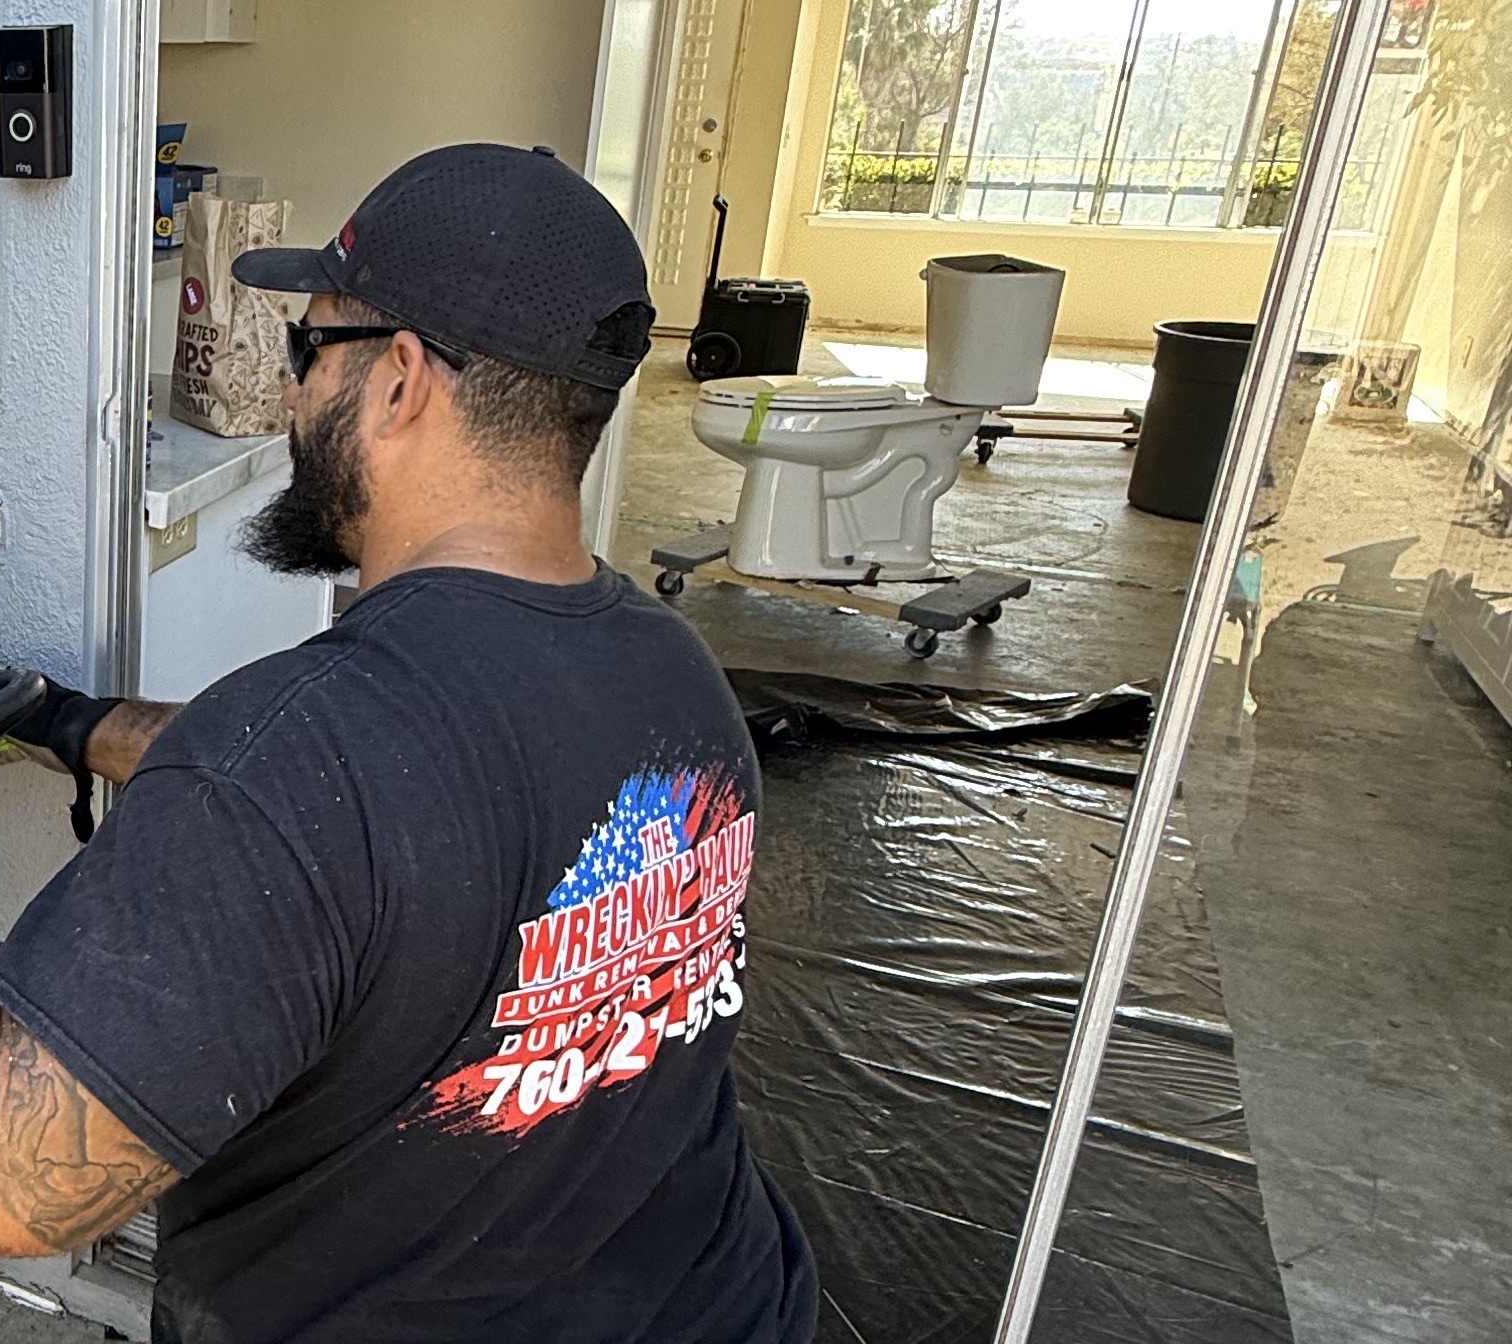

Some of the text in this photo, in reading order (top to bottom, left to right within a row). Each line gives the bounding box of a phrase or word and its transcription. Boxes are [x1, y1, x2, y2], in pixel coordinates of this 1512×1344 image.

[15, 162, 32, 175] ring
[638, 815, 676, 866] THE
[497, 974, 652, 1056] DUMPSTR
[504, 982, 575, 1017] JUNK
